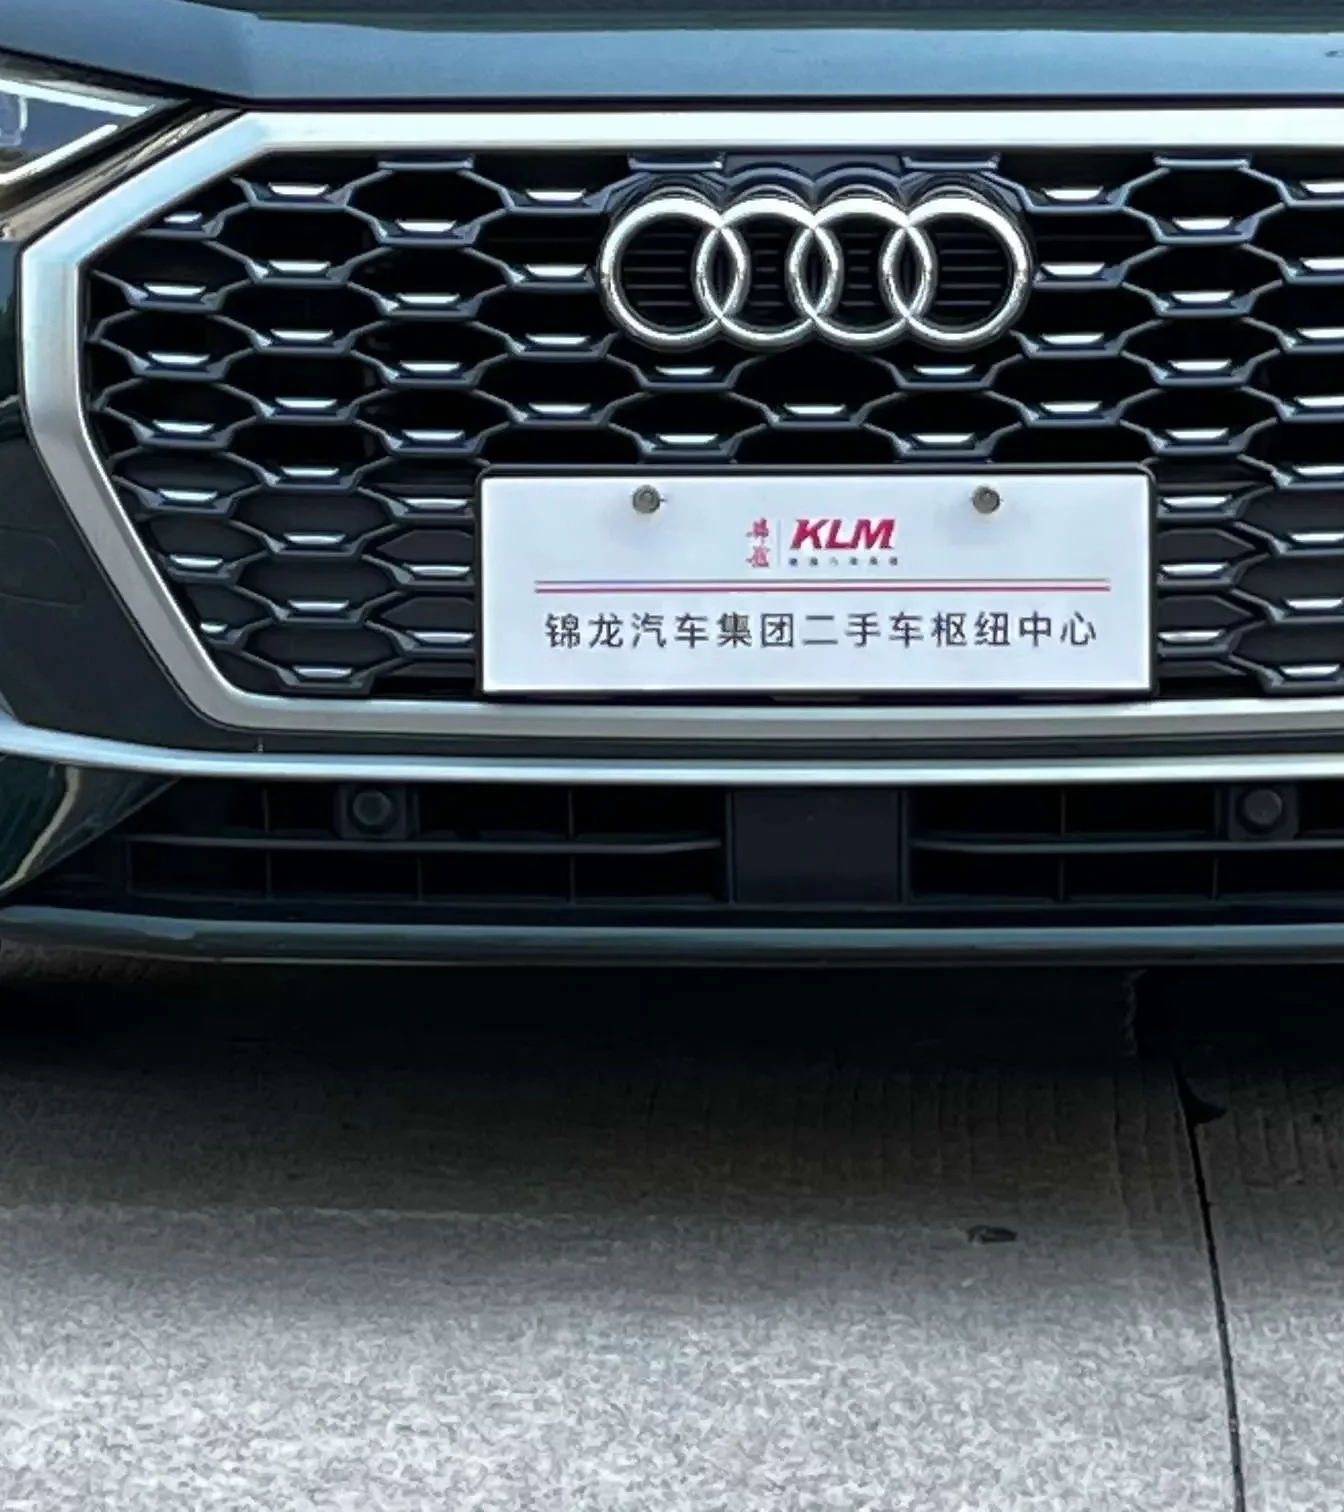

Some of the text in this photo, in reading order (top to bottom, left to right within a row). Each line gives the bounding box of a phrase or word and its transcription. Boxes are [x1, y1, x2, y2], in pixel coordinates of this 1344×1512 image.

[790, 518, 896, 550] KLM
[544, 611, 1098, 649] 锦龙汽车集团二手车枢纽中心
